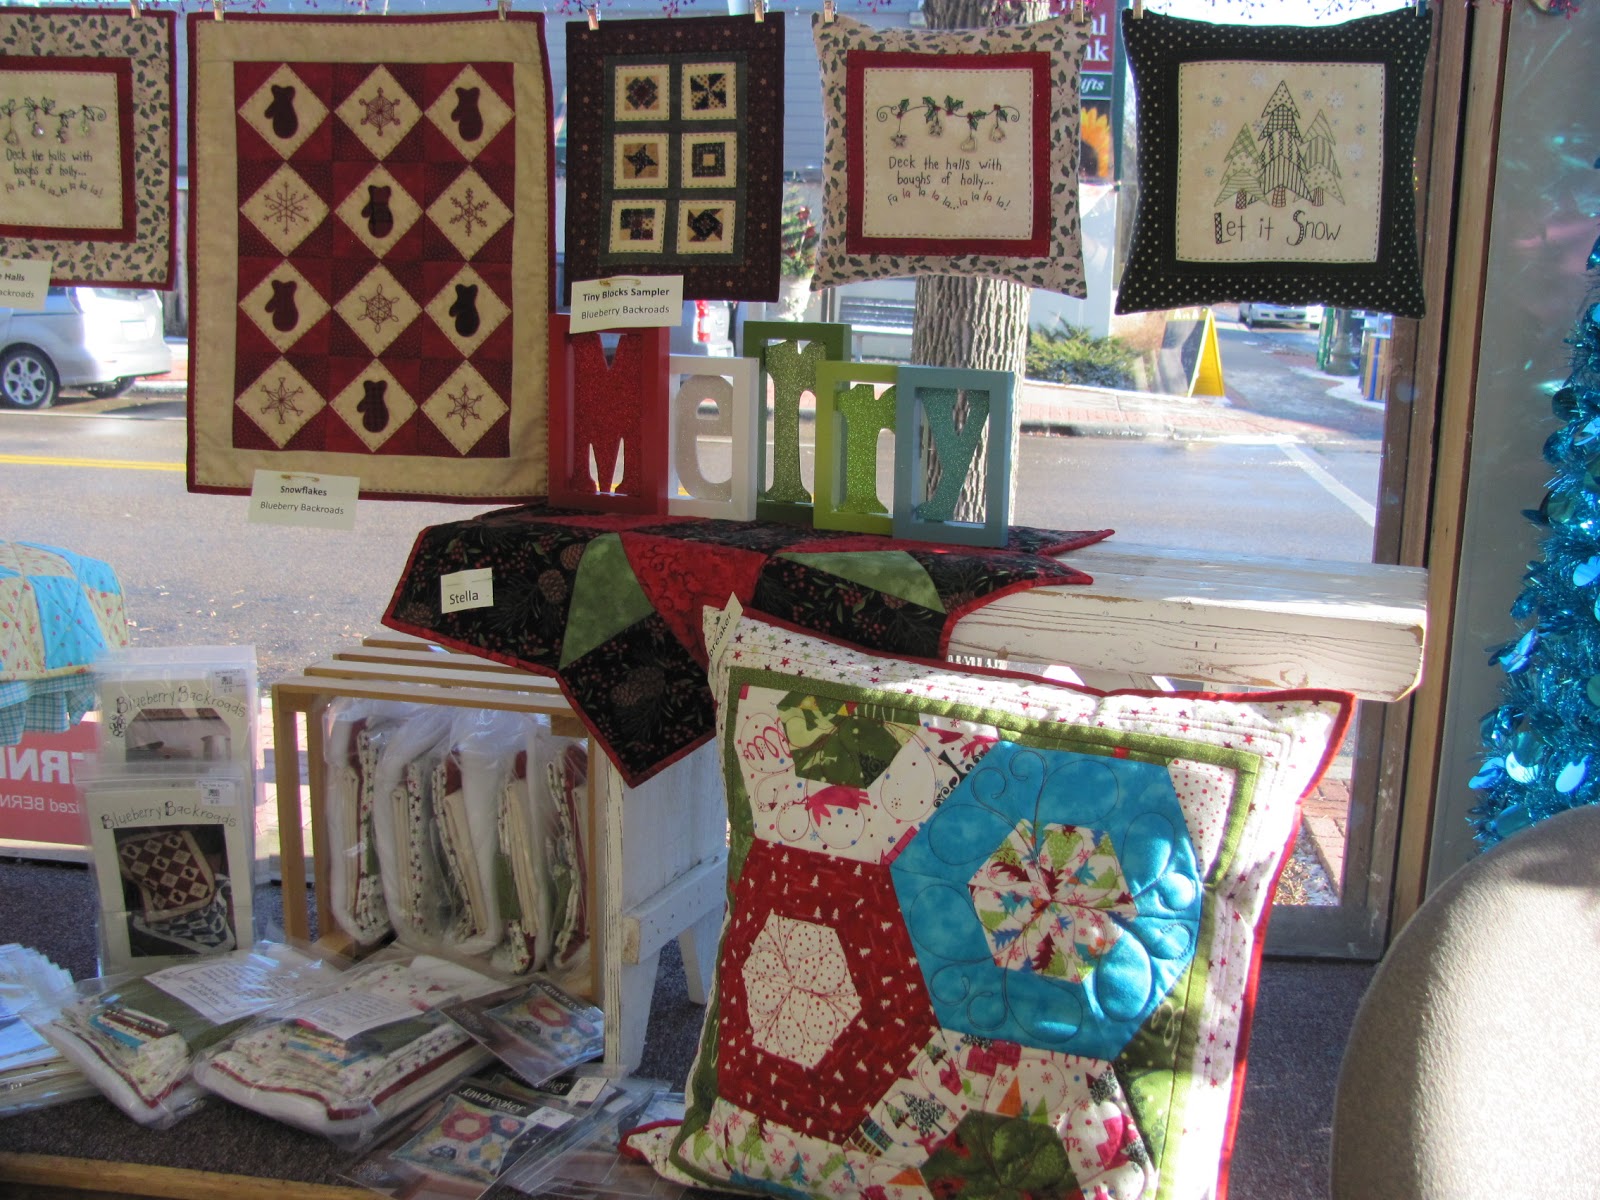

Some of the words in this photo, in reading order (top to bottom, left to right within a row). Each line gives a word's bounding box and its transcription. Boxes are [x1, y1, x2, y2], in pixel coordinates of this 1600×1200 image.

[1081, 78, 1105, 93] ifts
[6, 148, 26, 161] Deck
[32, 148, 43, 161] the
[49, 149, 66, 162] halls
[72, 150, 93, 162] with
[45, 163, 53, 175] of
[889, 155, 915, 169] Deck
[924, 156, 939, 170] the
[946, 156, 970, 170] halls
[979, 157, 1002, 171] with
[897, 170, 931, 188] boughs
[941, 171, 952, 184] of
[902, 190, 911, 199] la
[918, 188, 926, 197] la
[931, 191, 940, 201] la
[971, 192, 979, 201] la
[983, 191, 992, 201] la
[1214, 212, 1246, 245] Let
[1259, 217, 1274, 241] it
[1286, 209, 1341, 246] Snow
[4, 273, 25, 281] Halls
[582, 293, 600, 302] Tiny
[602, 288, 628, 299] Blocks
[630, 287, 670, 298] Sampler
[581, 307, 620, 320] Blueberry
[622, 305, 670, 314] Backroads
[572, 333, 990, 522] Merry
[280, 485, 328, 496] Snowflakes
[260, 501, 298, 512] Blueberry
[301, 503, 344, 515] Backroads
[449, 590, 479, 605] Stella
[116, 690, 175, 714] Blueberry
[178, 685, 246, 718] Backroads
[101, 805, 162, 830] Blueberry
[165, 800, 237, 828] Backroads
[459, 1087, 527, 1113] Jawbreaker
